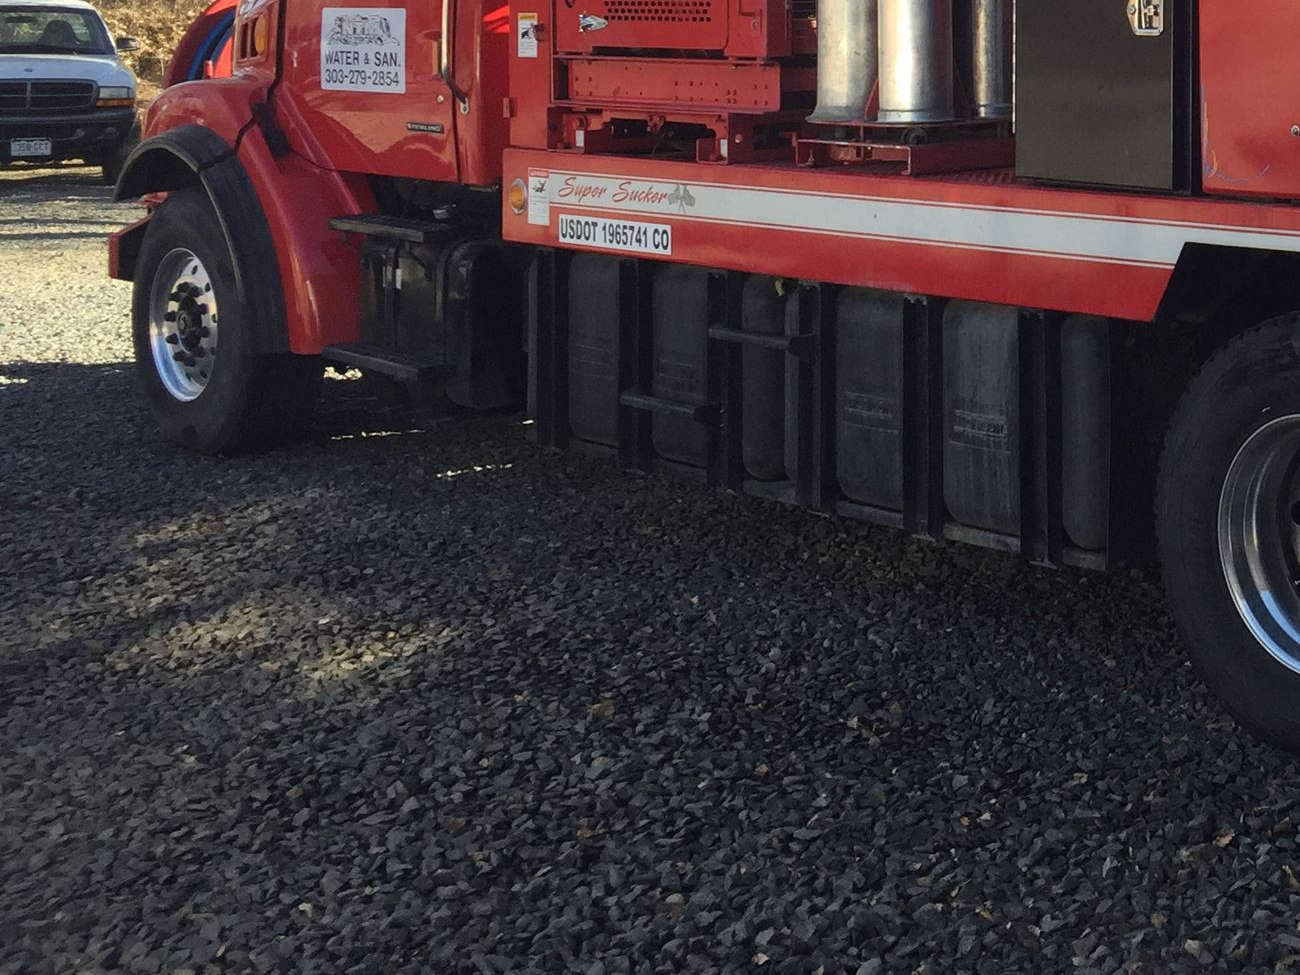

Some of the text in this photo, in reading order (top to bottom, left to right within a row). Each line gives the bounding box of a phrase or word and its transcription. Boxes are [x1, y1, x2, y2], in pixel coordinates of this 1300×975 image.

[325, 50, 401, 67] WATER & SAN.
[325, 68, 400, 87] 303-279-2854
[558, 176, 669, 204] Super Sucker
[560, 217, 670, 250] USDOT 1965741 CO
